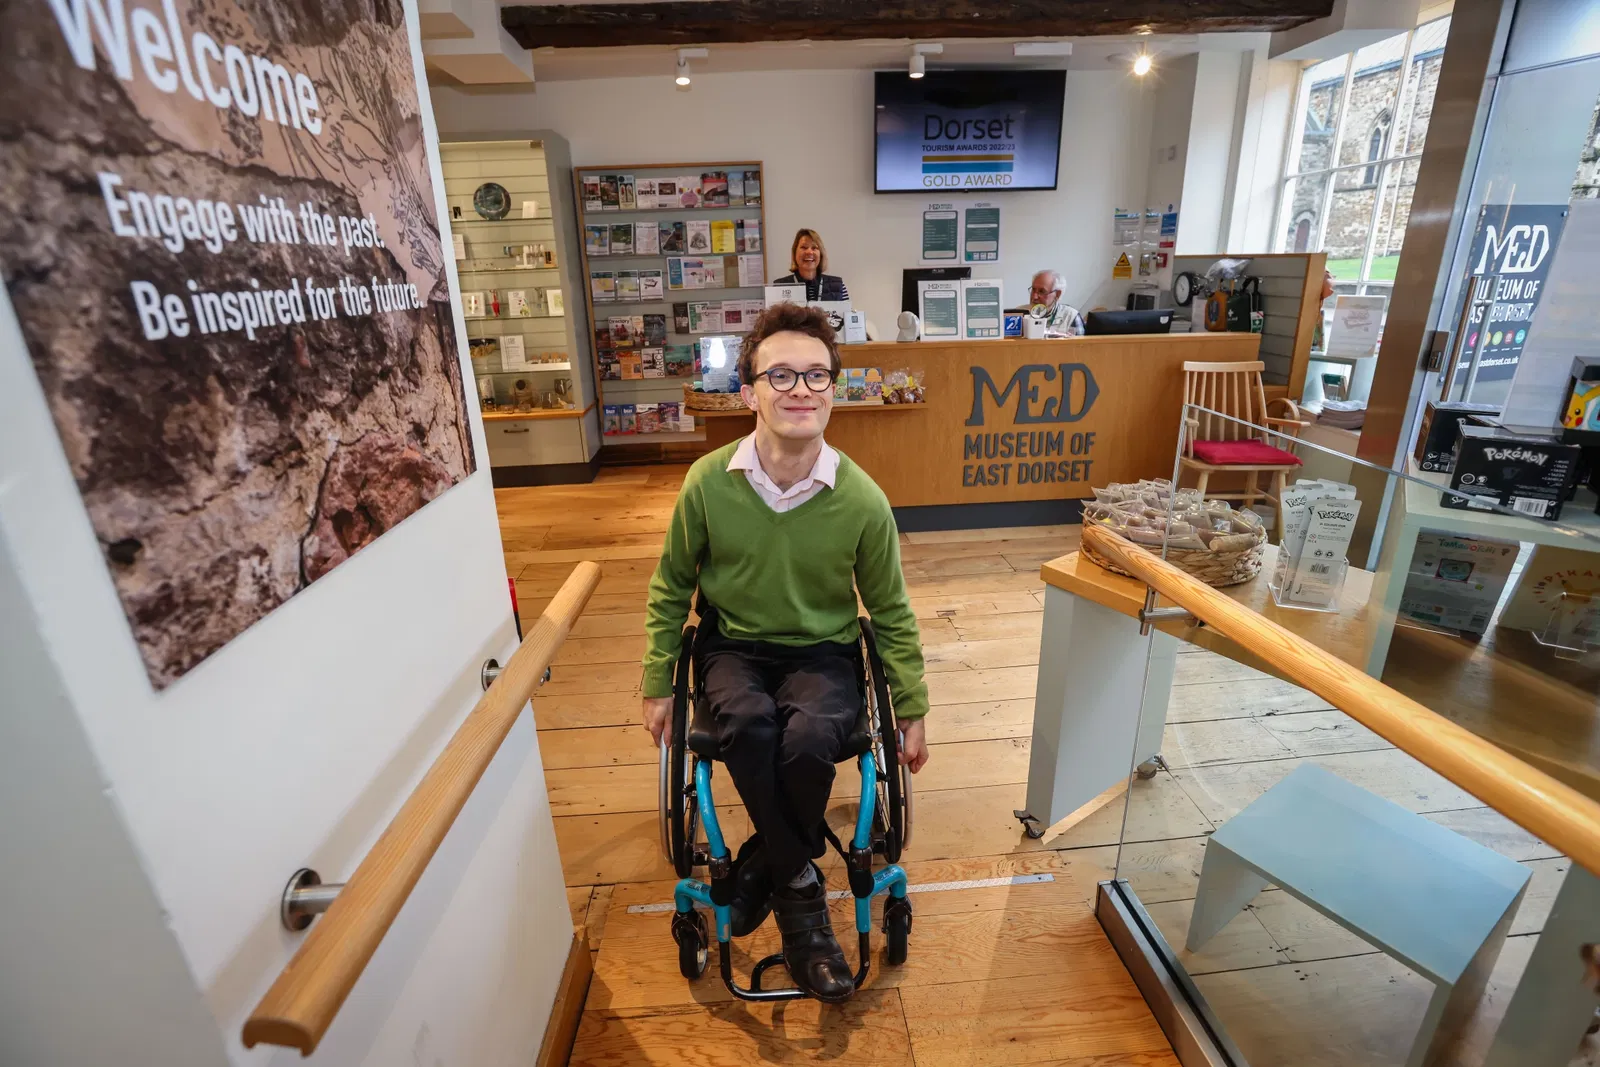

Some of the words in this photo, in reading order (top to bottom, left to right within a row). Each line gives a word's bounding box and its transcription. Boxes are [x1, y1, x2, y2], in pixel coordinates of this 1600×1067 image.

[48, 0, 323, 136] Welcome
[923, 114, 1015, 141] Dorset
[922, 144, 955, 152] TOURISM
[956, 144, 988, 152] AWARDS
[989, 143, 1015, 151] 2022/23
[922, 175, 960, 188] GOLD
[964, 174, 1013, 186] AWARD
[97, 171, 238, 254] Engage
[237, 194, 298, 246] with
[298, 198, 338, 245] the
[339, 211, 386, 257] past.
[1474, 225, 1550, 274] MED
[1478, 279, 1524, 301] UEUM
[1524, 280, 1540, 299] OF
[130, 279, 189, 341] Be
[188, 278, 304, 340] inspired
[304, 281, 338, 322] for
[339, 279, 372, 317] the
[371, 275, 425, 312] future.
[965, 363, 1100, 427] MED
[964, 431, 1065, 460] MUSEUM
[1070, 432, 1096, 455] OF
[962, 463, 1012, 487] EAST
[1017, 460, 1094, 485] DORSET
